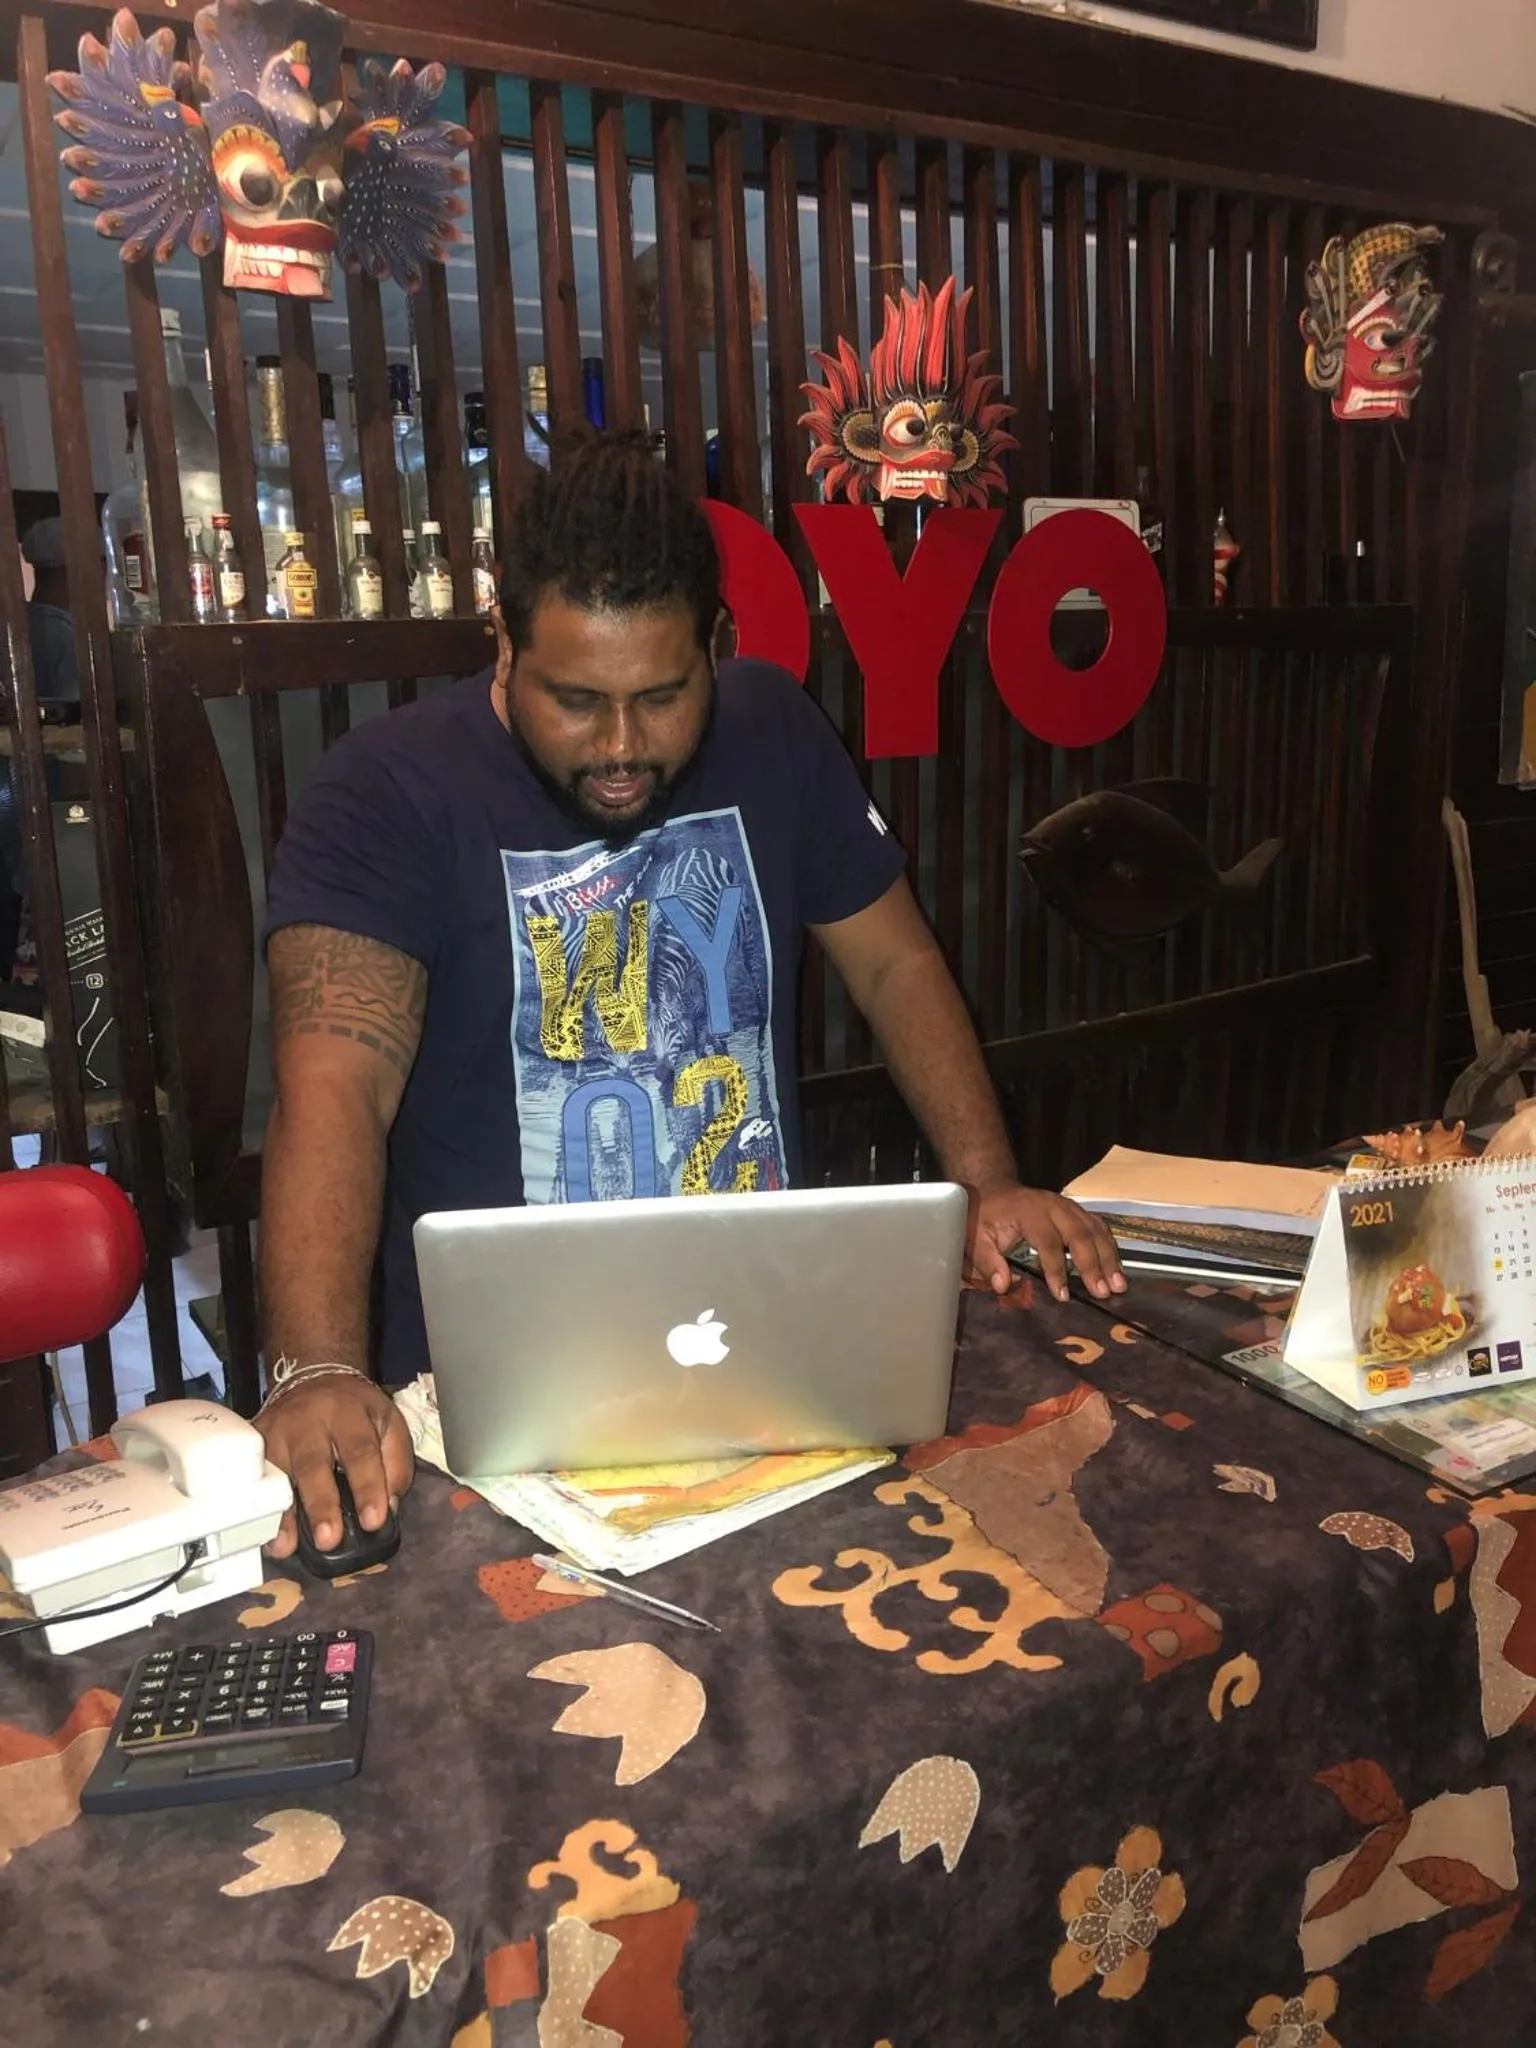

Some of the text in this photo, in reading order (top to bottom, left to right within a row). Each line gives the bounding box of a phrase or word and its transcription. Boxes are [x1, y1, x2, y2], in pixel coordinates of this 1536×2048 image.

[1350, 1201, 1394, 1228] 2021
[1231, 1344, 1279, 1364] 1000
[1368, 1374, 1384, 1386] NO
